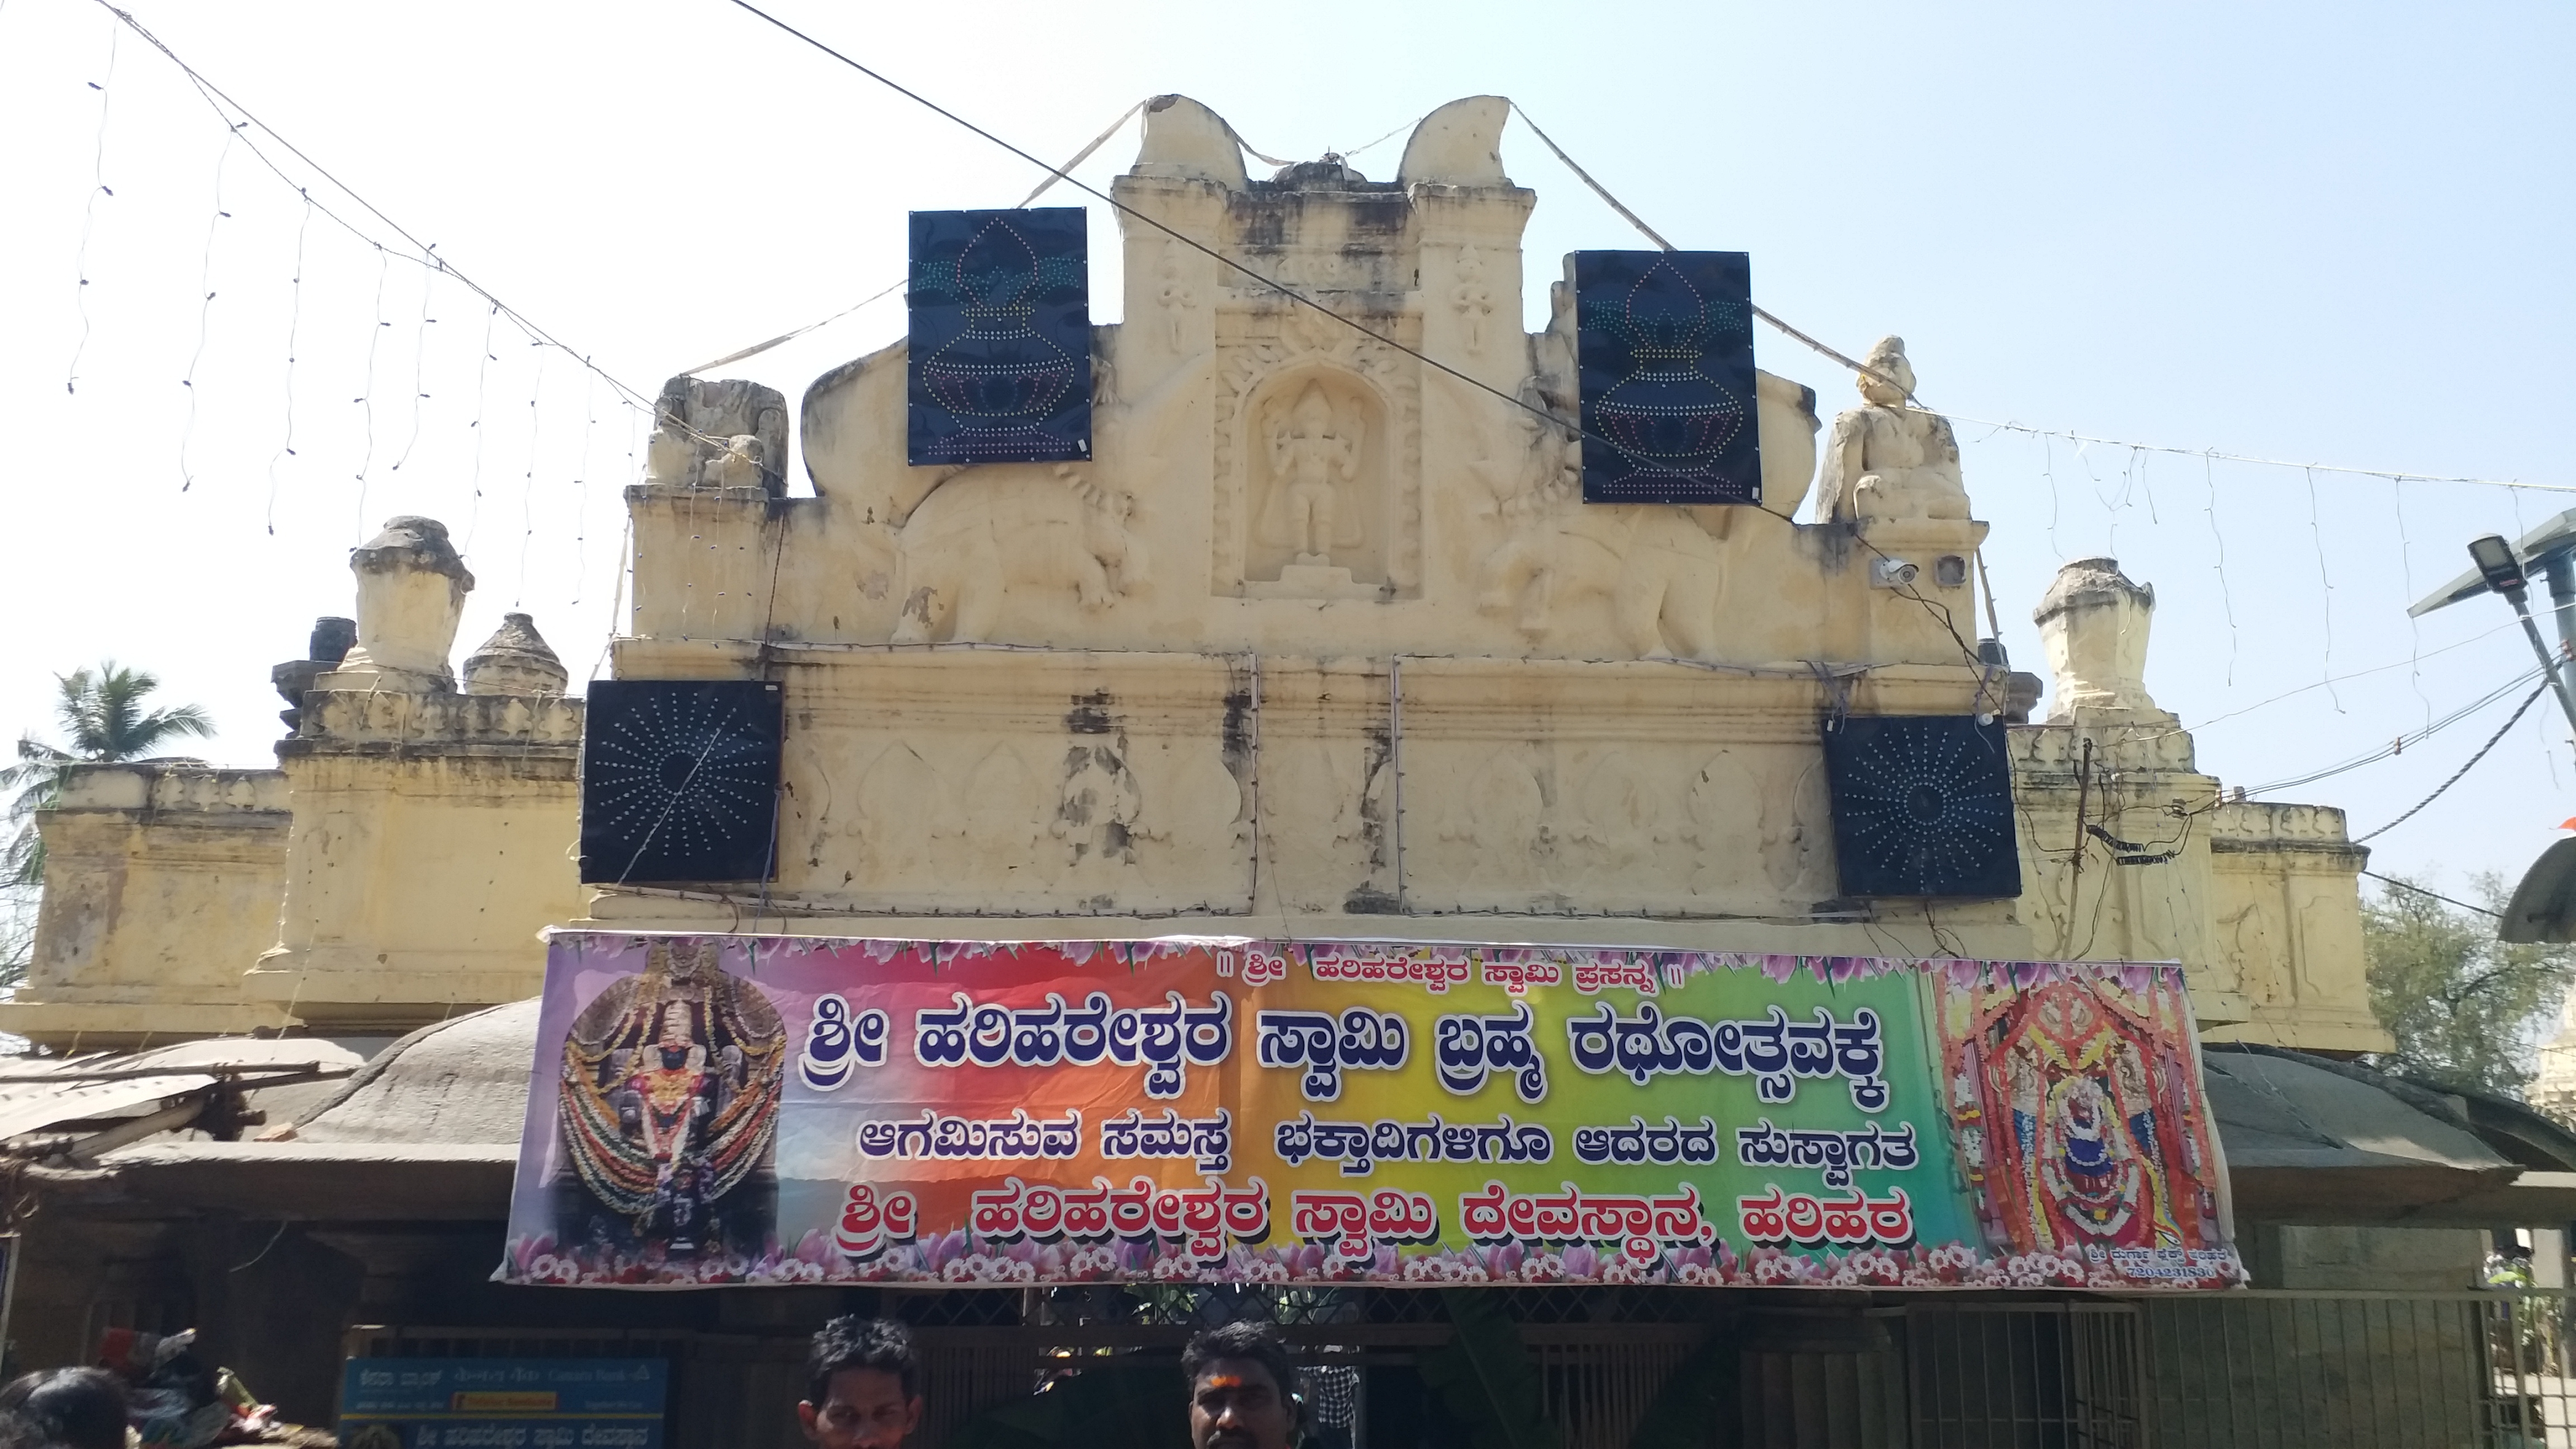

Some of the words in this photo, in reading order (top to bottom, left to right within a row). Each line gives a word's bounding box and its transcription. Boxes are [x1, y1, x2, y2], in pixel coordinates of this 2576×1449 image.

[1248, 952, 1284, 984] ಶ್ರೀ
[1315, 955, 1468, 992] ಹರಿಹರೇಶ್ವರ
[1485, 962, 1559, 993] ಸ್ವಾಮಿ
[1575, 961, 1656, 995] ಪ್ರಸನ್ನ
[802, 997, 887, 1089] ಶ್ರೀ
[917, 992, 1230, 1097] ಹರಿಹರೇಶ್ವರ
[1259, 1008, 1407, 1100] ಸ್ವಾಮಿ
[1437, 1003, 1545, 1101] ಬ್ರಹ್ಮ
[1572, 1005, 1887, 1109] ರಥೋತ್ಸವಕ್ಕೆ
[860, 1112, 1079, 1158] ಆಗಮಿಸುವ
[1104, 1111, 1230, 1172] ಸಮಸ್ತ
[1276, 1112, 1550, 1175] ಭಕ್ತಾದಿಗಳಿಗೂ
[1575, 1118, 1715, 1165] ಆದರದ
[1739, 1120, 1917, 1186] ಸುಸ್ವಾಗತ
[837, 1183, 913, 1253] ಶ್ರೀ
[974, 1179, 1268, 1260] ಹರಿಹರೇಶ್ವರ
[1294, 1191, 1436, 1260] ಸ್ವಾಮಿ
[1461, 1182, 1715, 1266] ದೇವಸ್ಥಾನ,
[1739, 1186, 1911, 1242] ಹರಿಹರ
[2090, 1248, 2106, 1262] ಶ್ರೀ
